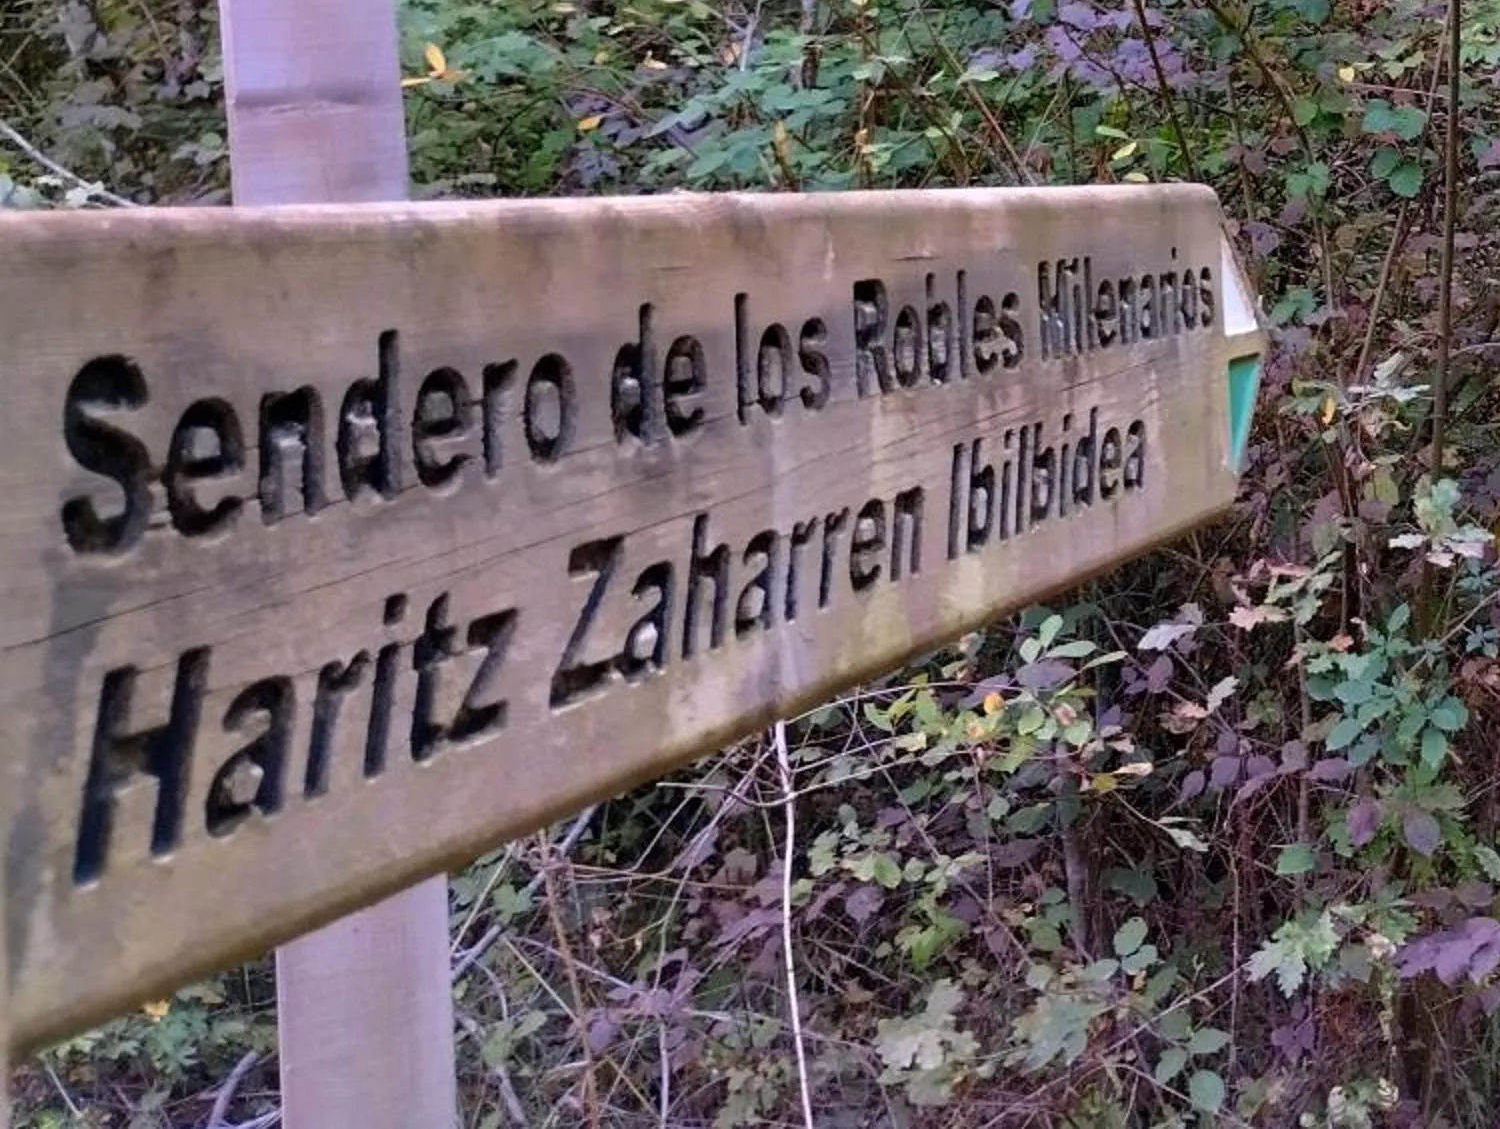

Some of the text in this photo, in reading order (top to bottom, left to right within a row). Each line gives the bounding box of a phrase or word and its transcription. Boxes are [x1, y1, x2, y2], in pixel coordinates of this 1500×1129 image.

[62, 246, 1213, 554] Sendero de los Robles Milenarios
[73, 406, 1145, 885] Haritz Zaharren Ibilbidea
